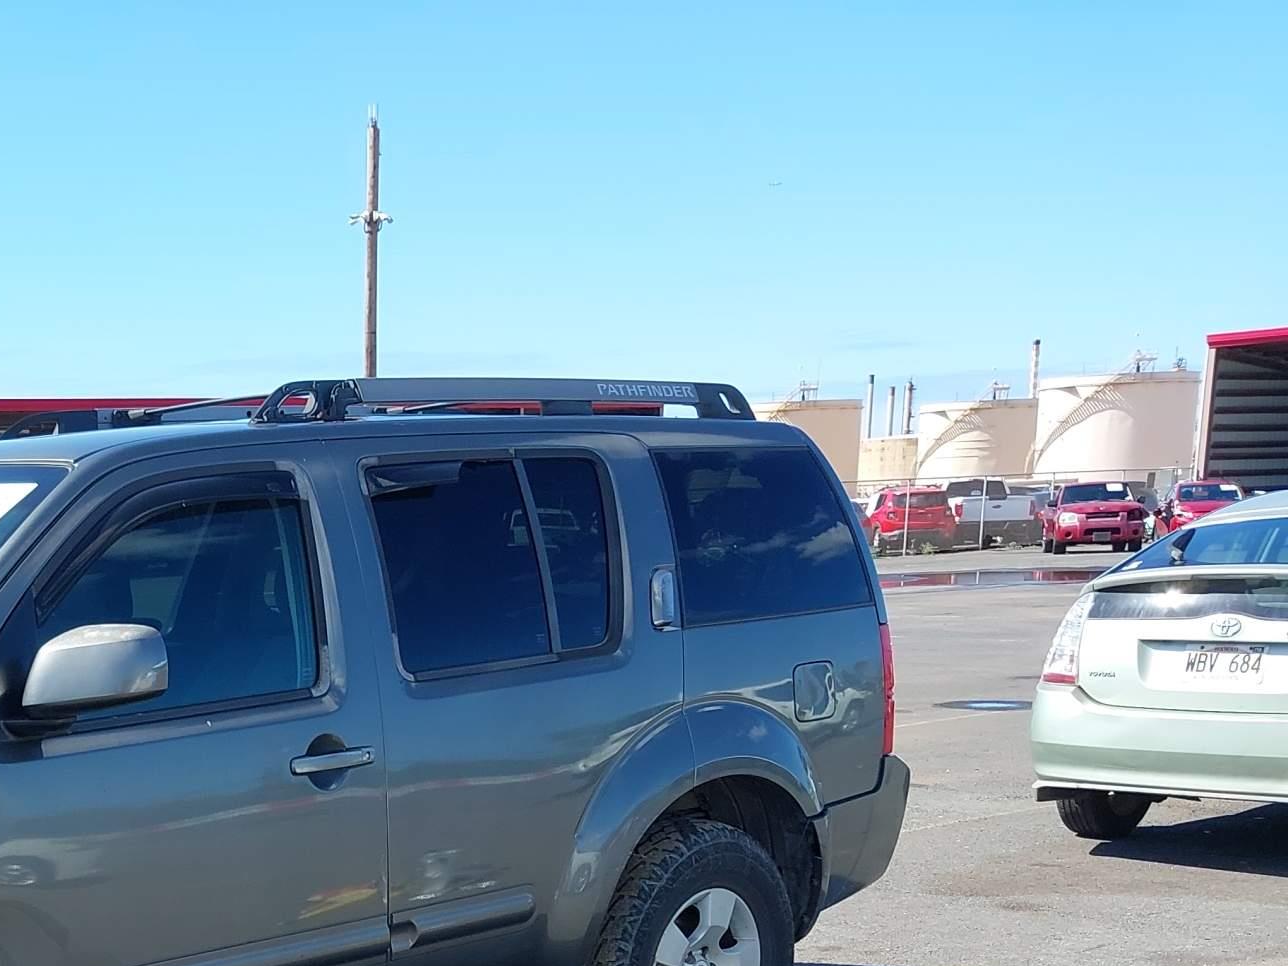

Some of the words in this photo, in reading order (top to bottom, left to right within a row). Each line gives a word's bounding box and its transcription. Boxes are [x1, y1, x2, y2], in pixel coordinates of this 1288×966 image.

[597, 383, 694, 397] PATHFINDER
[1185, 652, 1220, 673] WBV
[1228, 653, 1262, 674] 684
